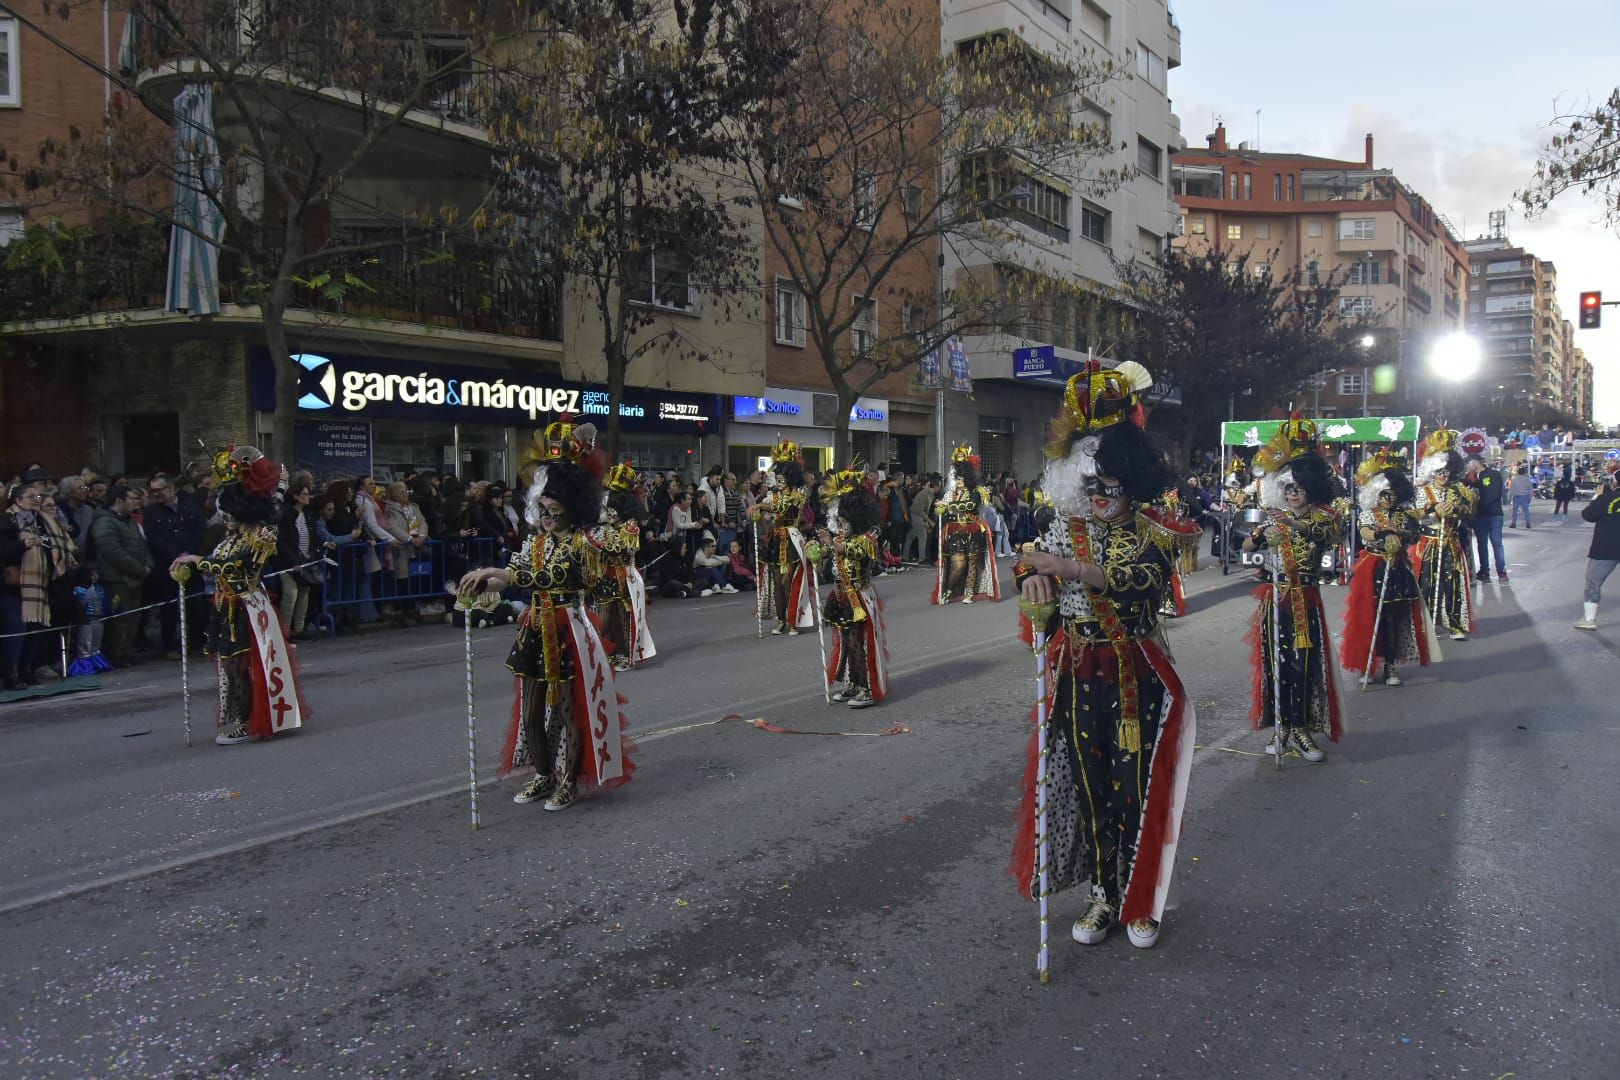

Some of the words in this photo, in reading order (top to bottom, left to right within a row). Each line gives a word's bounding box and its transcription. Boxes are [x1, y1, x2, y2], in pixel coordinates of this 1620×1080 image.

[1023, 357, 1045, 365] BANCA
[1023, 363, 1045, 371] PUEYO
[583, 391, 610, 404] agenc
[583, 401, 645, 417] inmoliaria
[664, 403, 676, 413] 924
[676, 404, 687, 413] 237
[687, 405, 699, 415] 777
[767, 399, 801, 415] Sanitas
[858, 407, 886, 421] Sanitas
[351, 424, 367, 432] vivir
[341, 432, 348, 440] la
[318, 440, 333, 448] más
[335, 441, 367, 449] moderna
